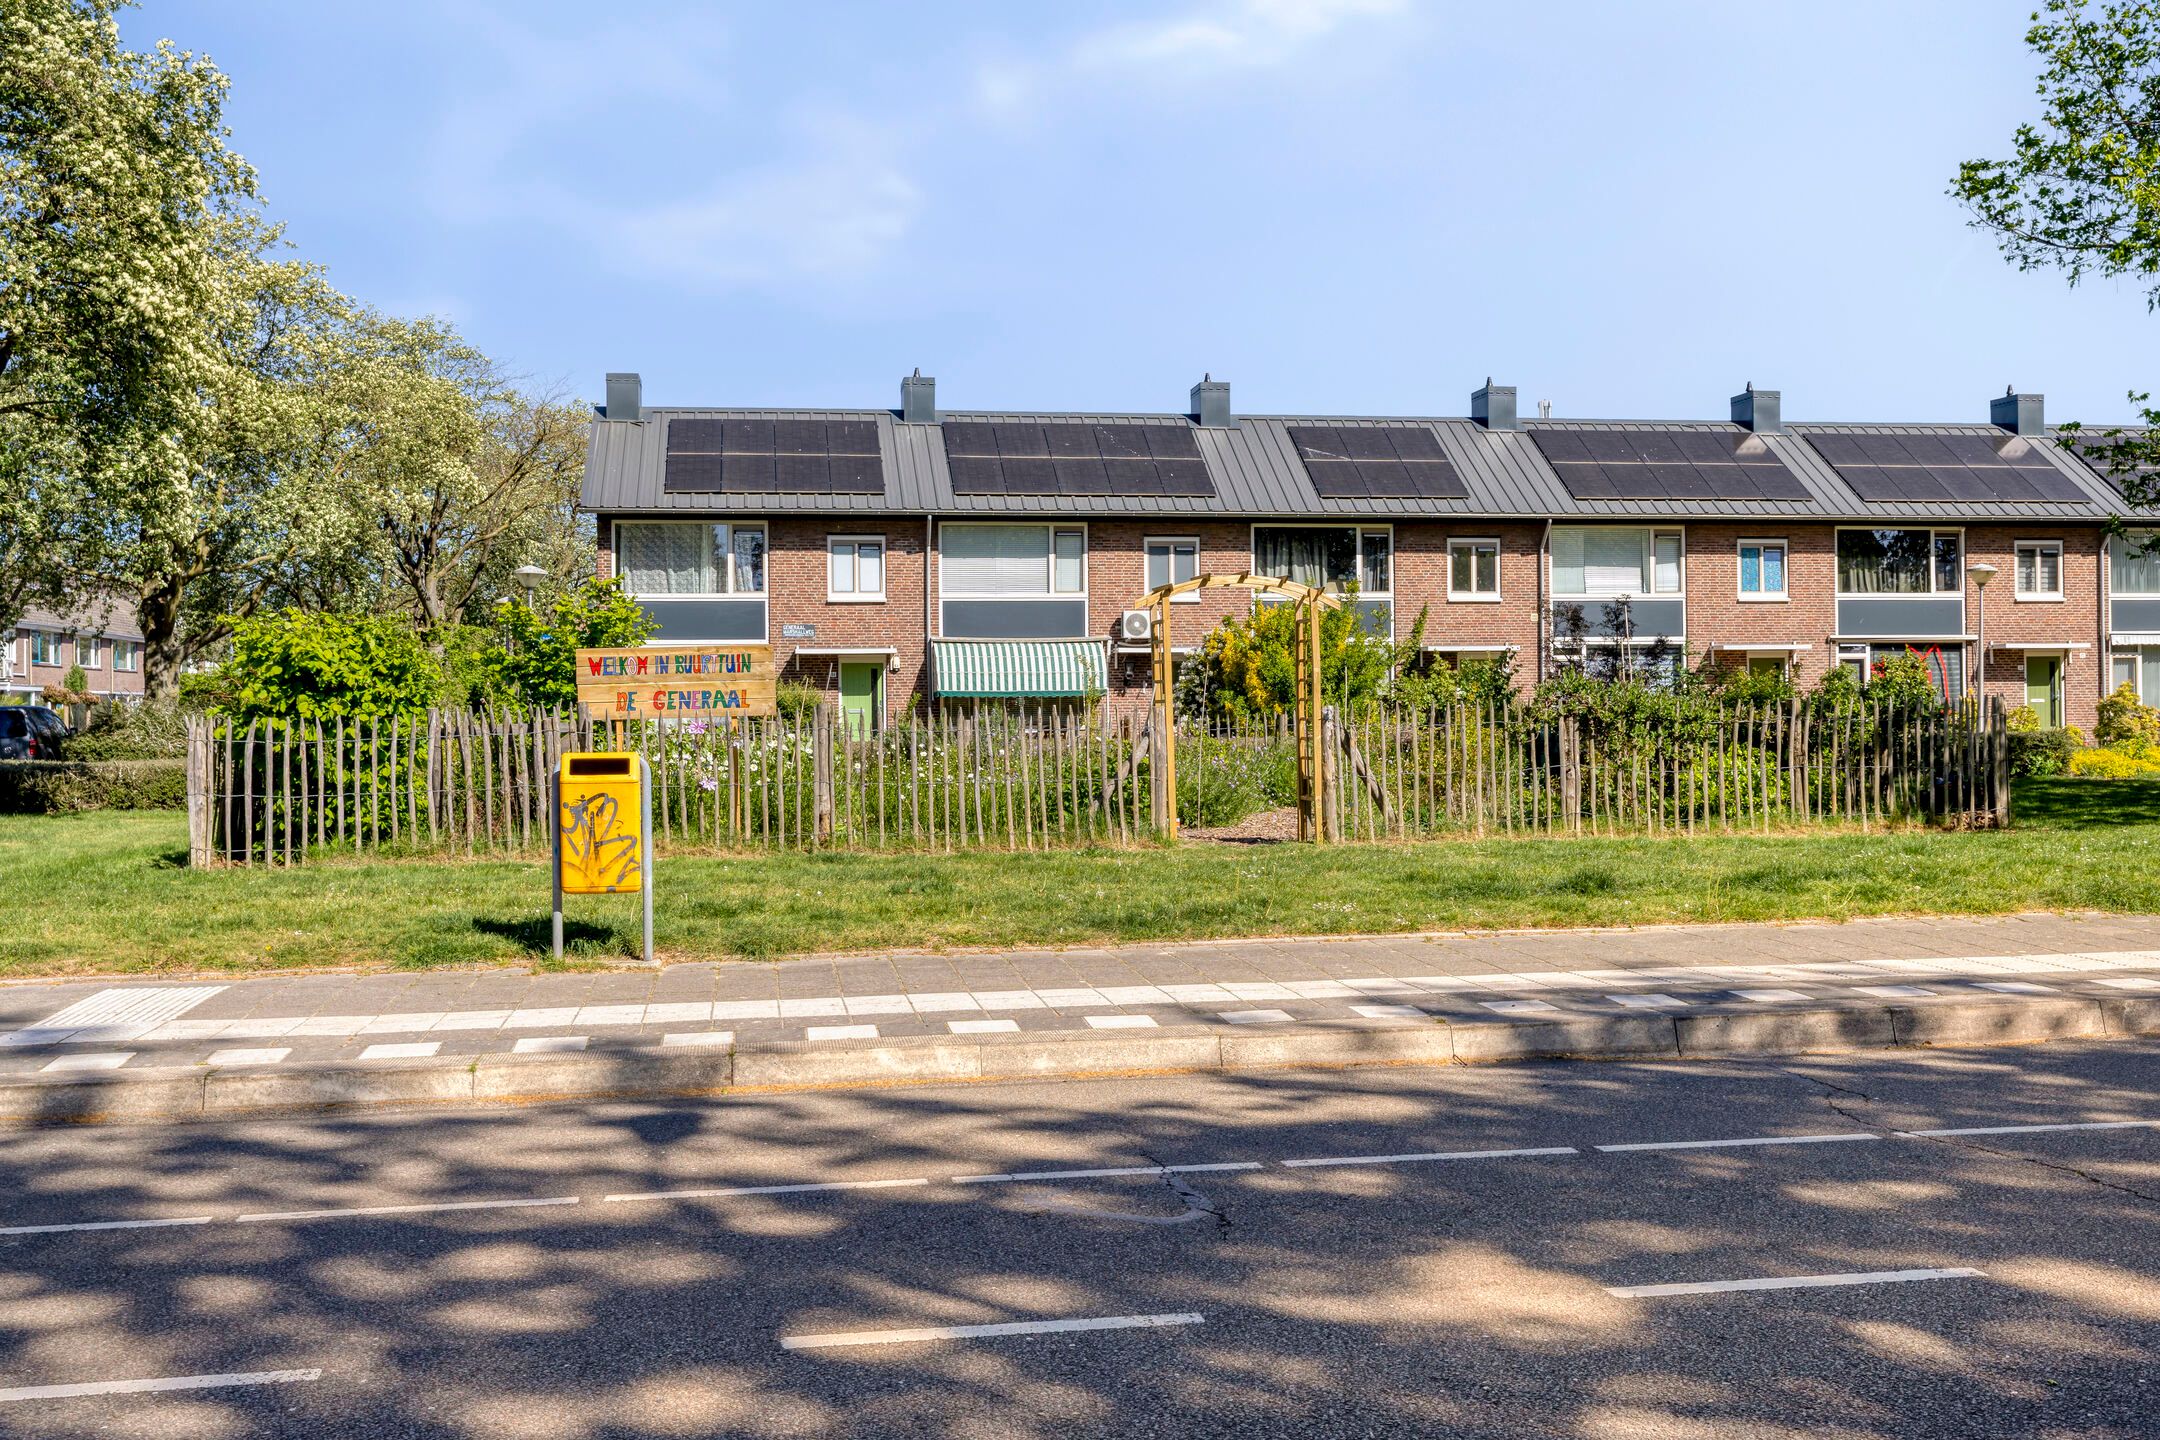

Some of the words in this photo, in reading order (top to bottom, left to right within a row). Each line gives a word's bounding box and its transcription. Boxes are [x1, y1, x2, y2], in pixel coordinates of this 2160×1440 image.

[588, 656, 648, 676] WELKOM
[655, 655, 669, 674] IN
[675, 653, 751, 674] BUURTTUIN
[616, 691, 637, 711] DE
[653, 689, 750, 710] GENERAAL
